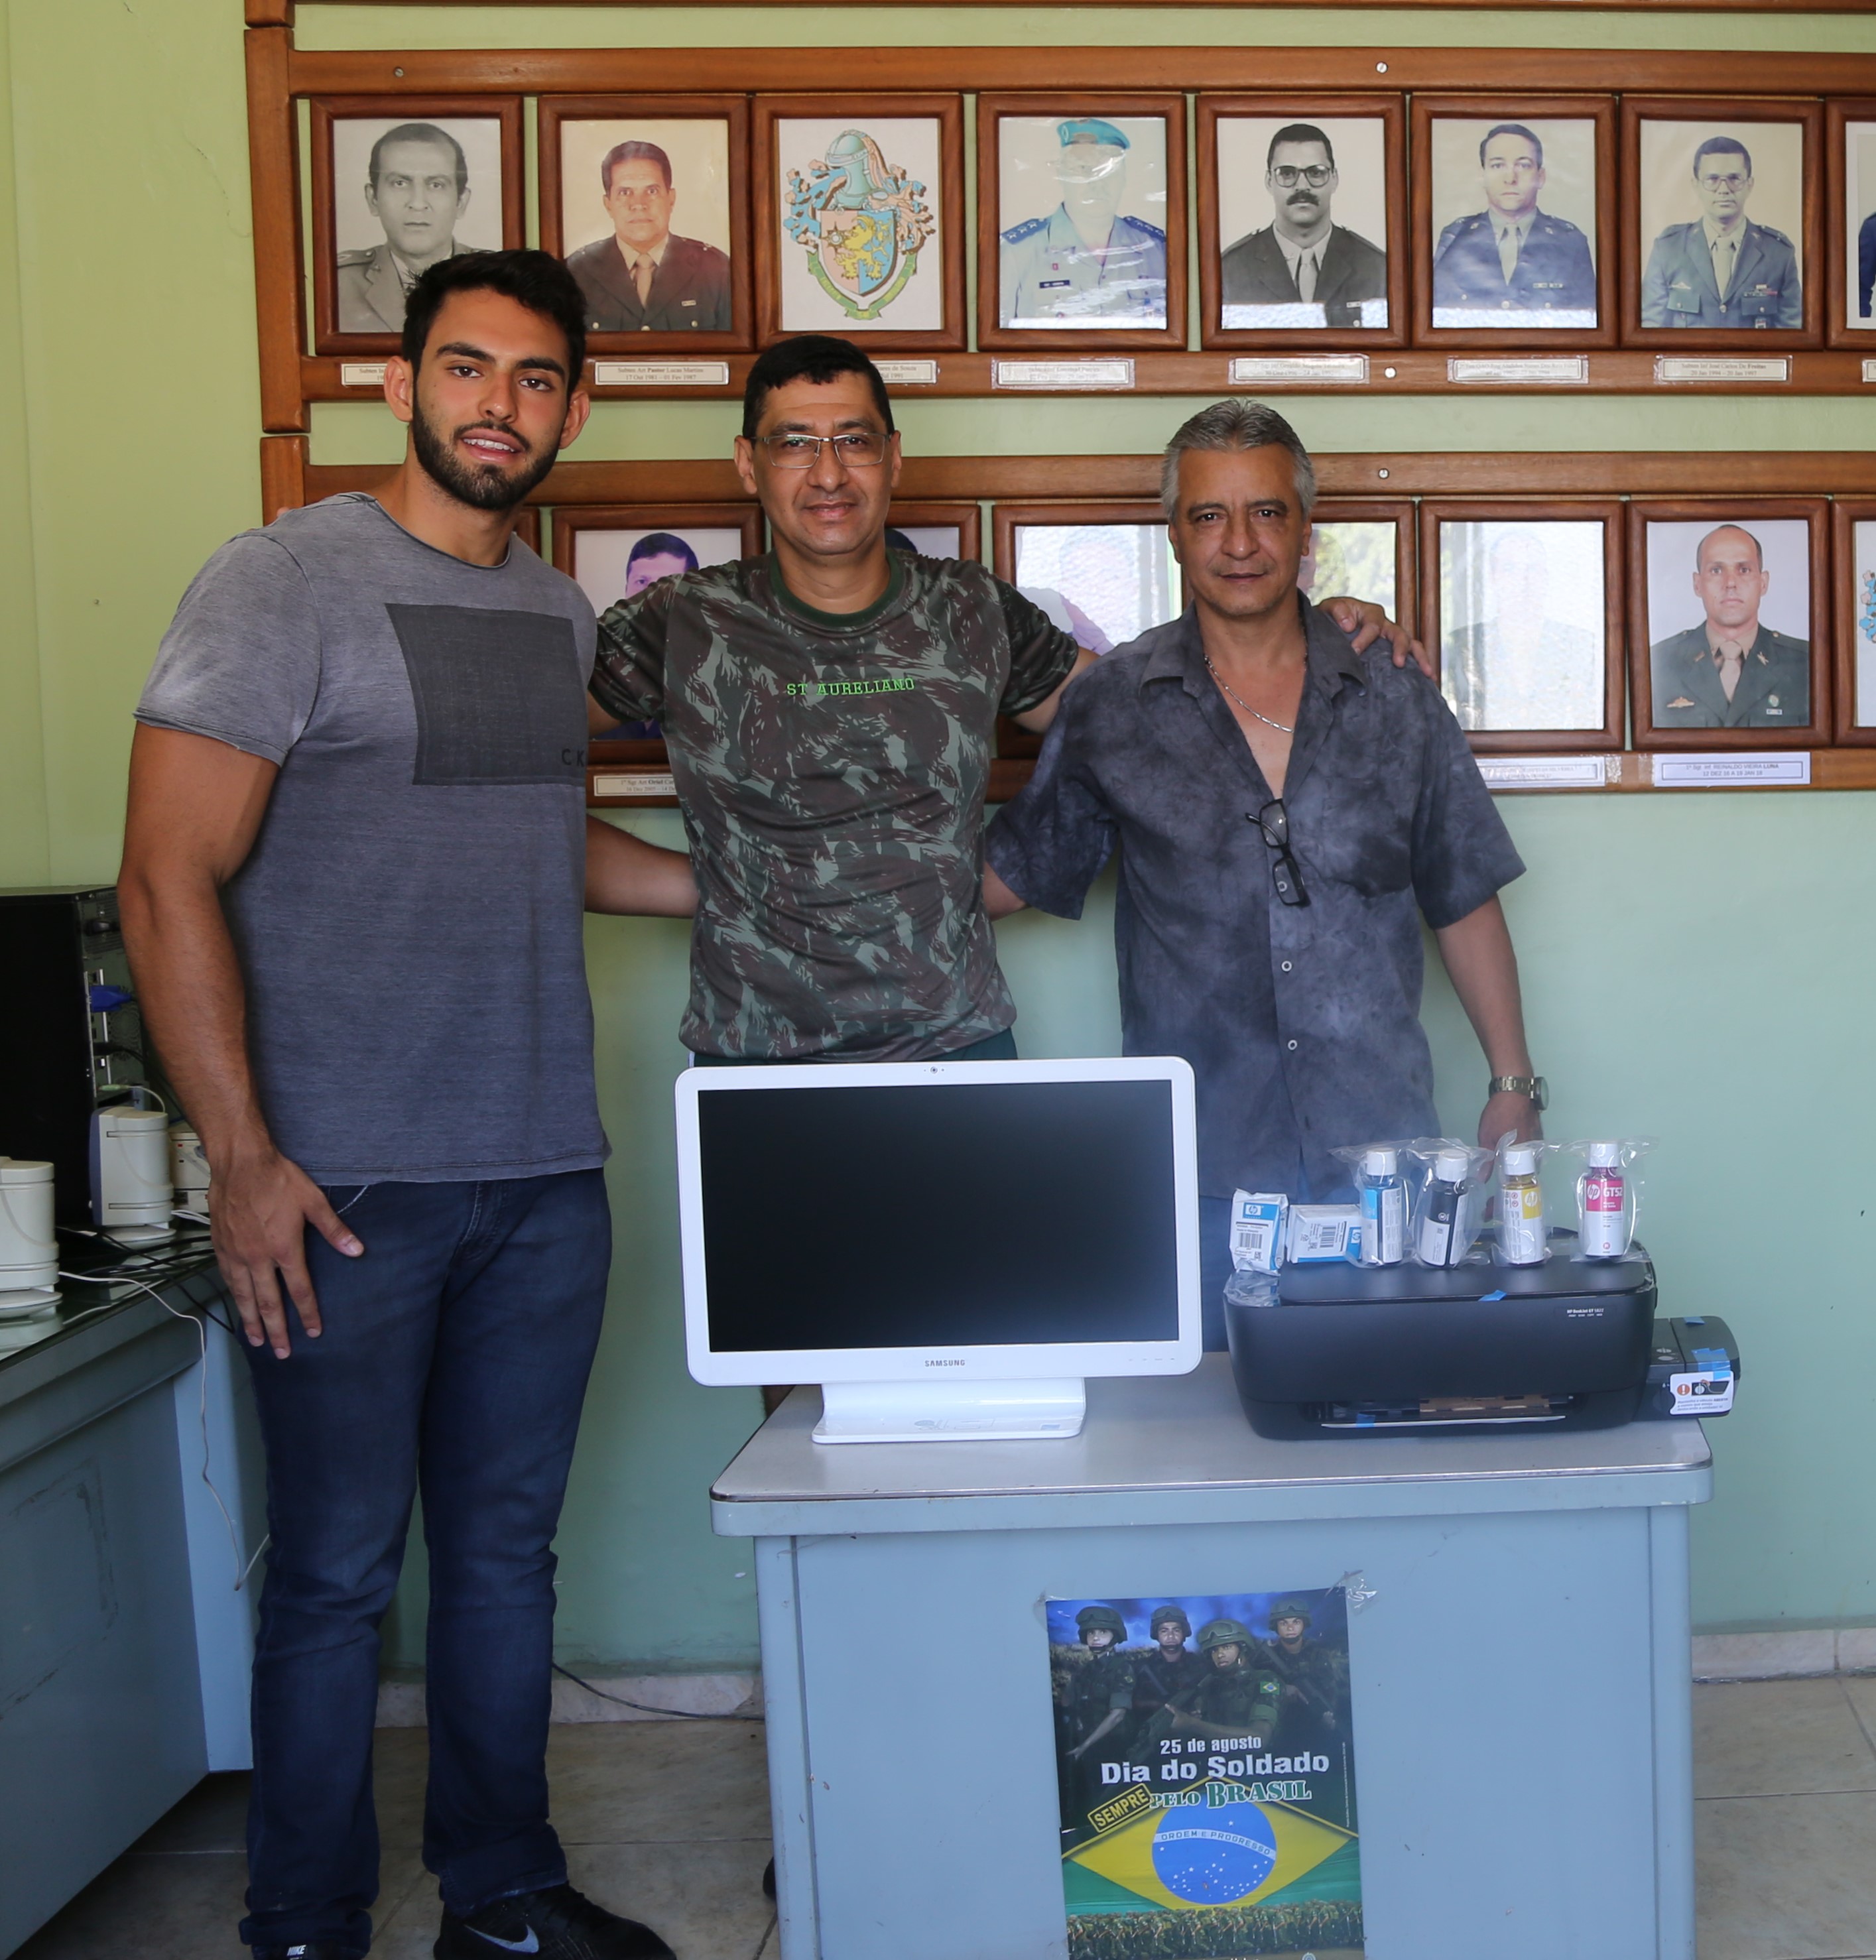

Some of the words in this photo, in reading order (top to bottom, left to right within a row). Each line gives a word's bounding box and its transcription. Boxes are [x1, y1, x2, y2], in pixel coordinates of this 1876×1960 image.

[787, 683, 808, 696] ST
[816, 677, 915, 696] AURELIANO
[1587, 1184, 1600, 1200] hp
[1160, 1739, 1182, 1754] 25
[1188, 1738, 1206, 1752] de
[1212, 1735, 1262, 1752] agosto
[1101, 1761, 1151, 1784] Dia
[1161, 1758, 1198, 1781] do
[1208, 1751, 1330, 1778] Soldado
[1094, 1788, 1149, 1827] SEMPRE
[1150, 1791, 1200, 1809] PELO
[1206, 1780, 1312, 1809] BRASIL
[1161, 1830, 1198, 1841] ORDEM
[1210, 1831, 1271, 1856] PROGRESSO
[286, 1945, 306, 1957] NIKE
